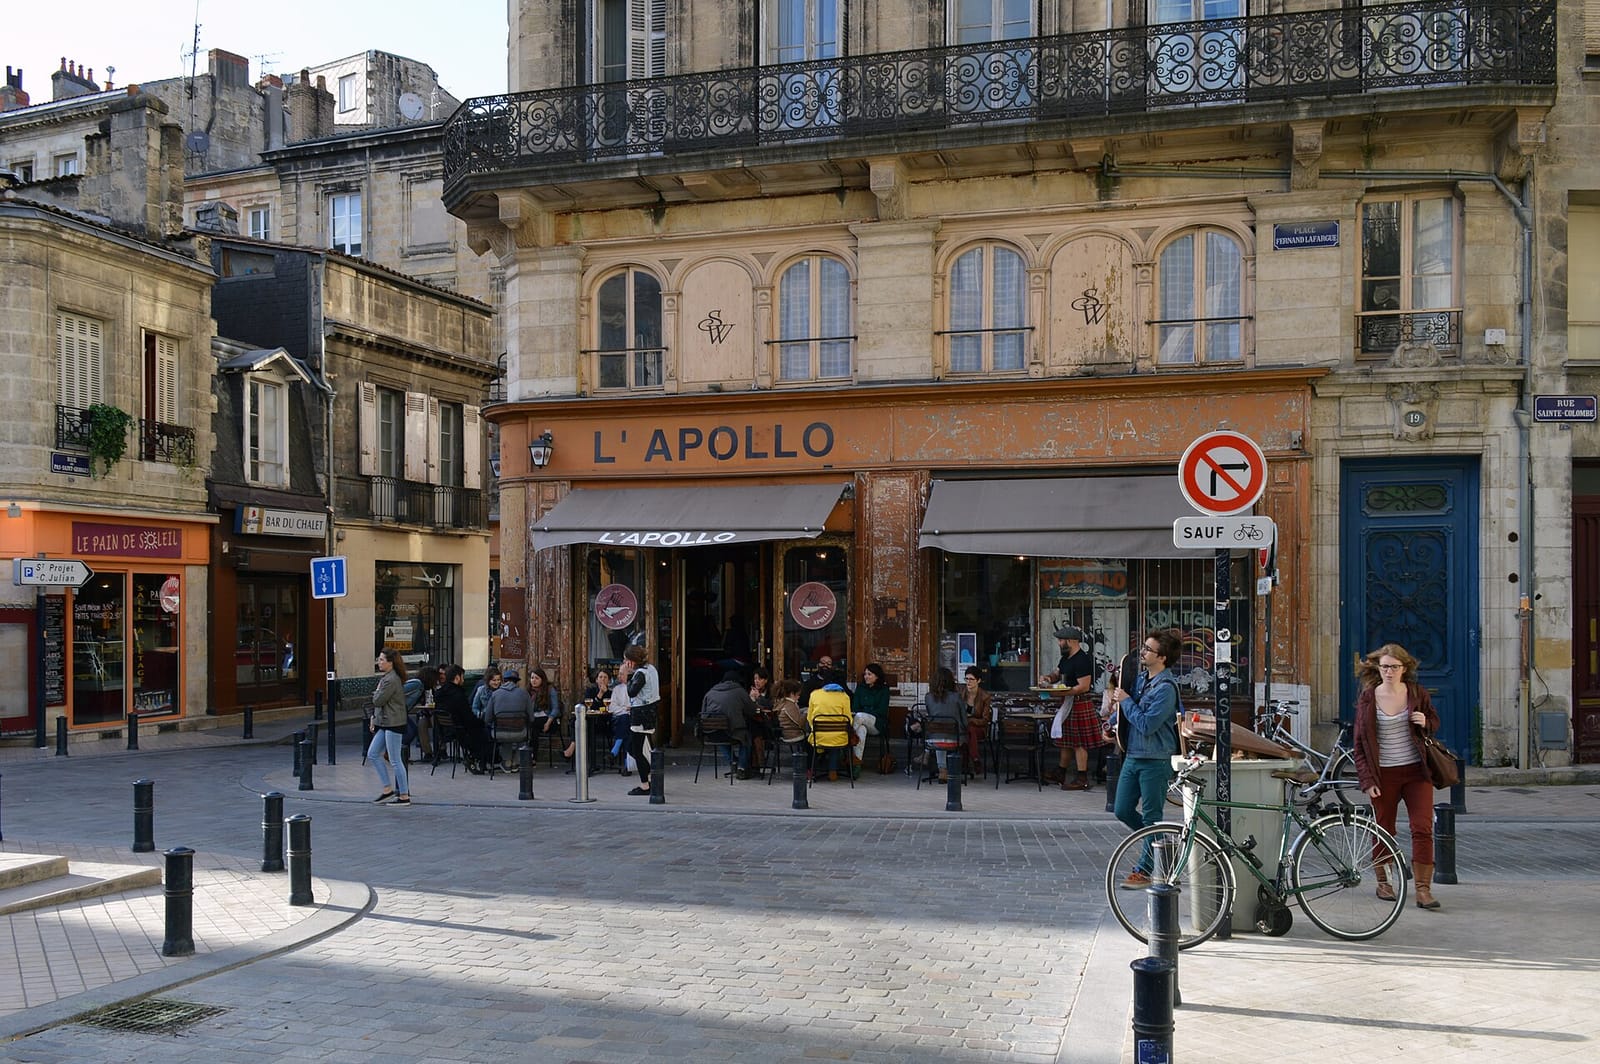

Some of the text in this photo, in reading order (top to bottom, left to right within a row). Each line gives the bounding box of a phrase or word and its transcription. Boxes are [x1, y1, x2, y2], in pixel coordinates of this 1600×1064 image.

[1294, 226, 1317, 235] PLACE
[1276, 234, 1337, 245] FERNAND LAFARGUE
[1557, 399, 1575, 407] RUE
[1537, 409, 1595, 417] SAINTE-COLOMBE
[1410, 414, 1420, 423] 19
[265, 516, 280, 528] BAR
[282, 518, 294, 529] DU
[296, 519, 324, 530] CHALET
[1183, 526, 1225, 539] SAUF
[77, 530, 178, 552] LE PAIN DE SOLEIL
[599, 532, 736, 545] L'APOLLO
[49, 564, 74, 573] Projet
